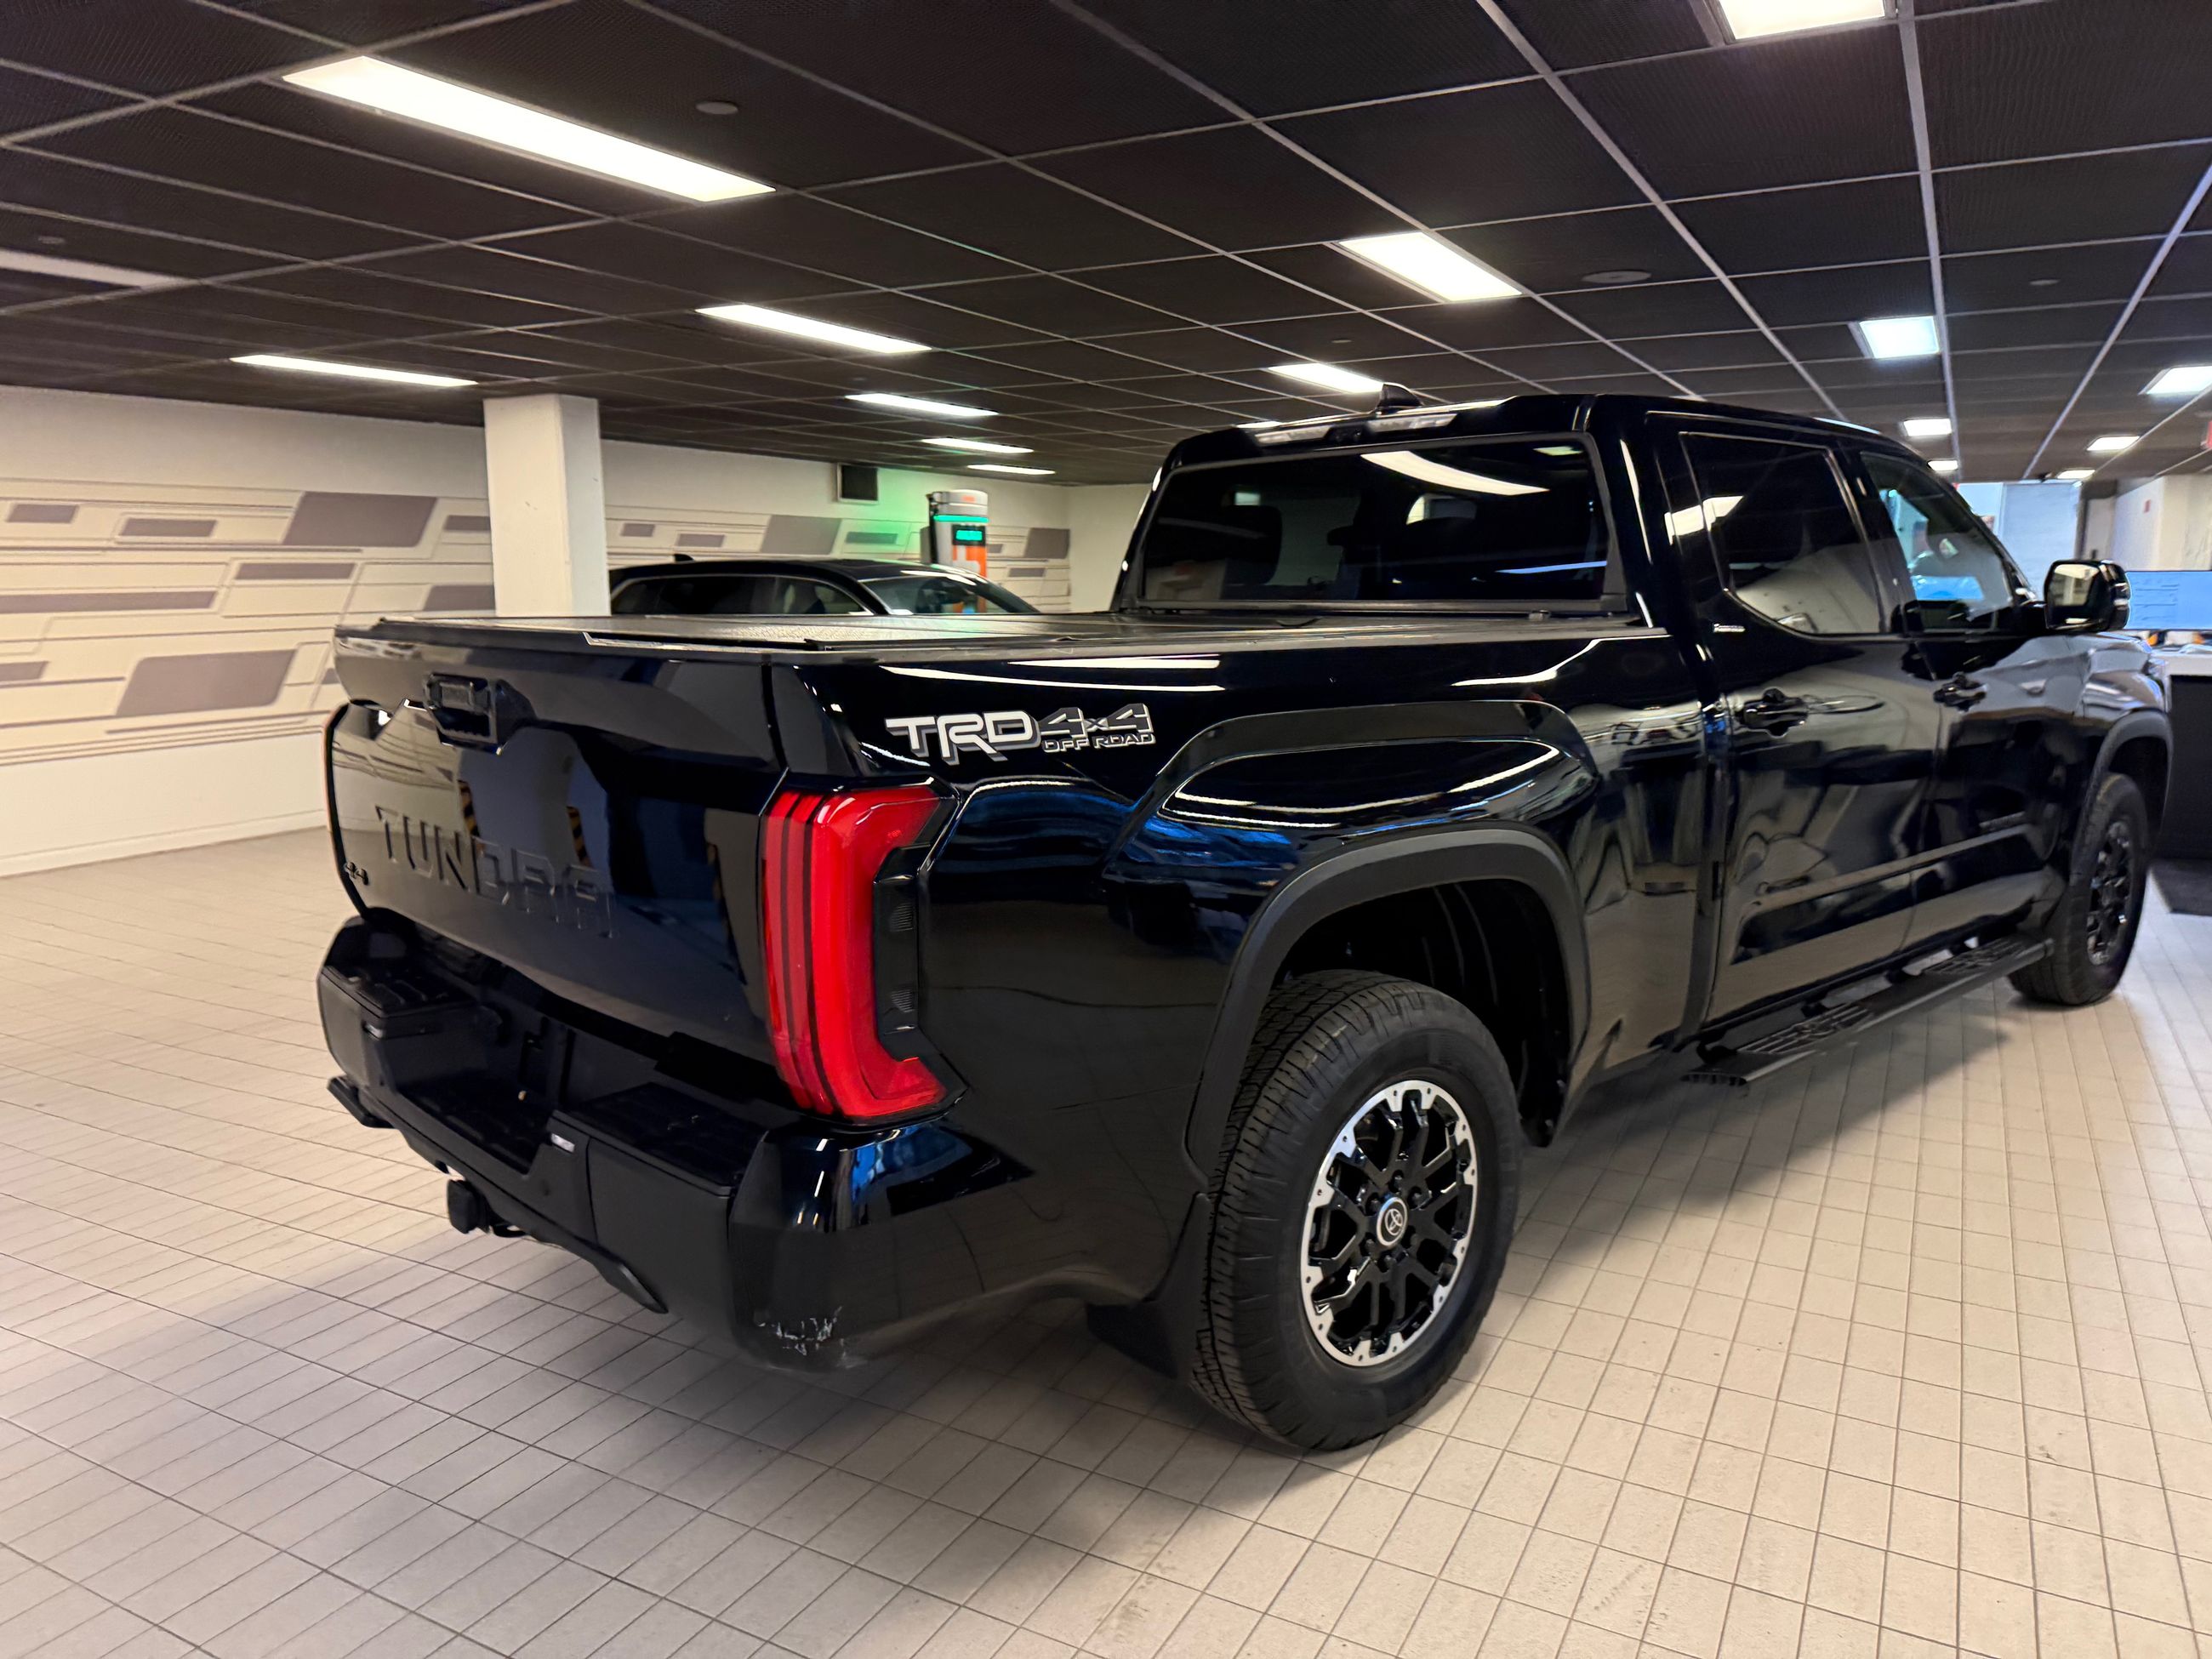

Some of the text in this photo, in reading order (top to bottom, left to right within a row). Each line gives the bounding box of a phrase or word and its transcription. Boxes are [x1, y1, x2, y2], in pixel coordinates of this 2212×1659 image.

[884, 710, 1041, 766] TRD
[1041, 732, 1156, 753] OFF ROAD
[374, 805, 613, 938] TUNDRA
